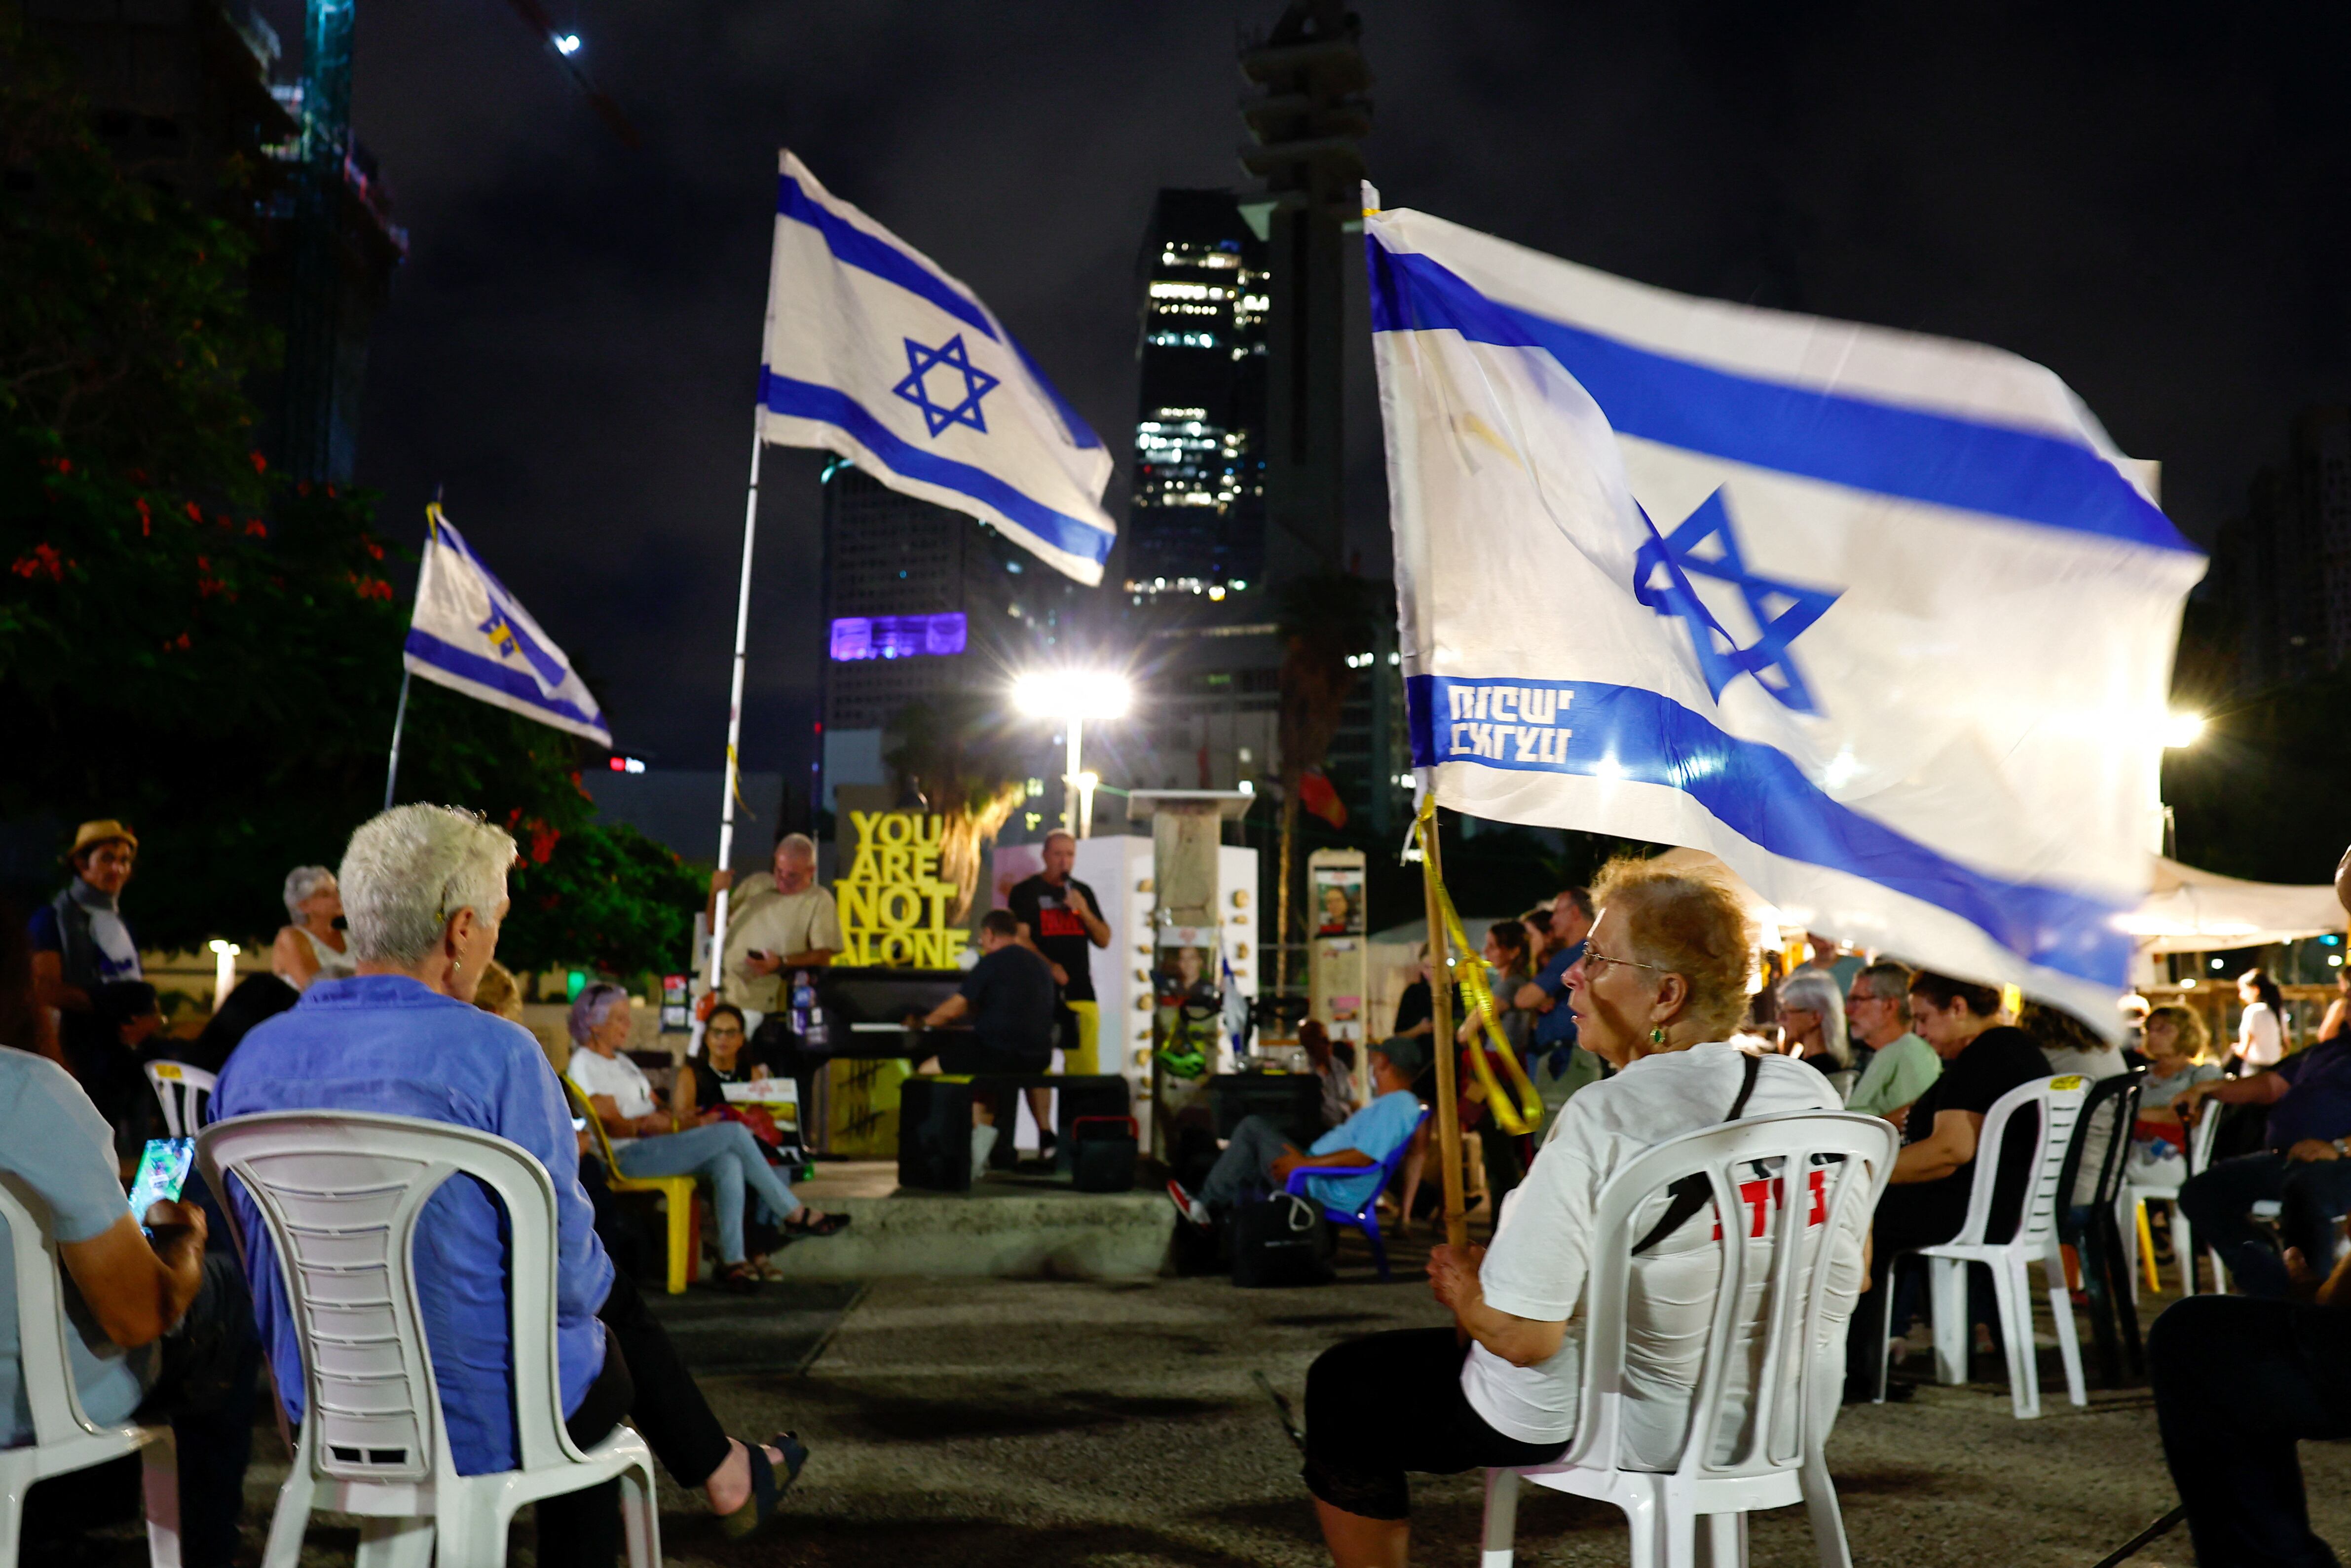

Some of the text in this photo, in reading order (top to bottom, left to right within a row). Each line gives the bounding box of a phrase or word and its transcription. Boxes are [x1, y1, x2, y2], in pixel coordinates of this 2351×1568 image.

[849, 811, 942, 846] YOU
[848, 844, 940, 885] ARE
[832, 879, 958, 931] NOT
[829, 928, 970, 970] ALONE
